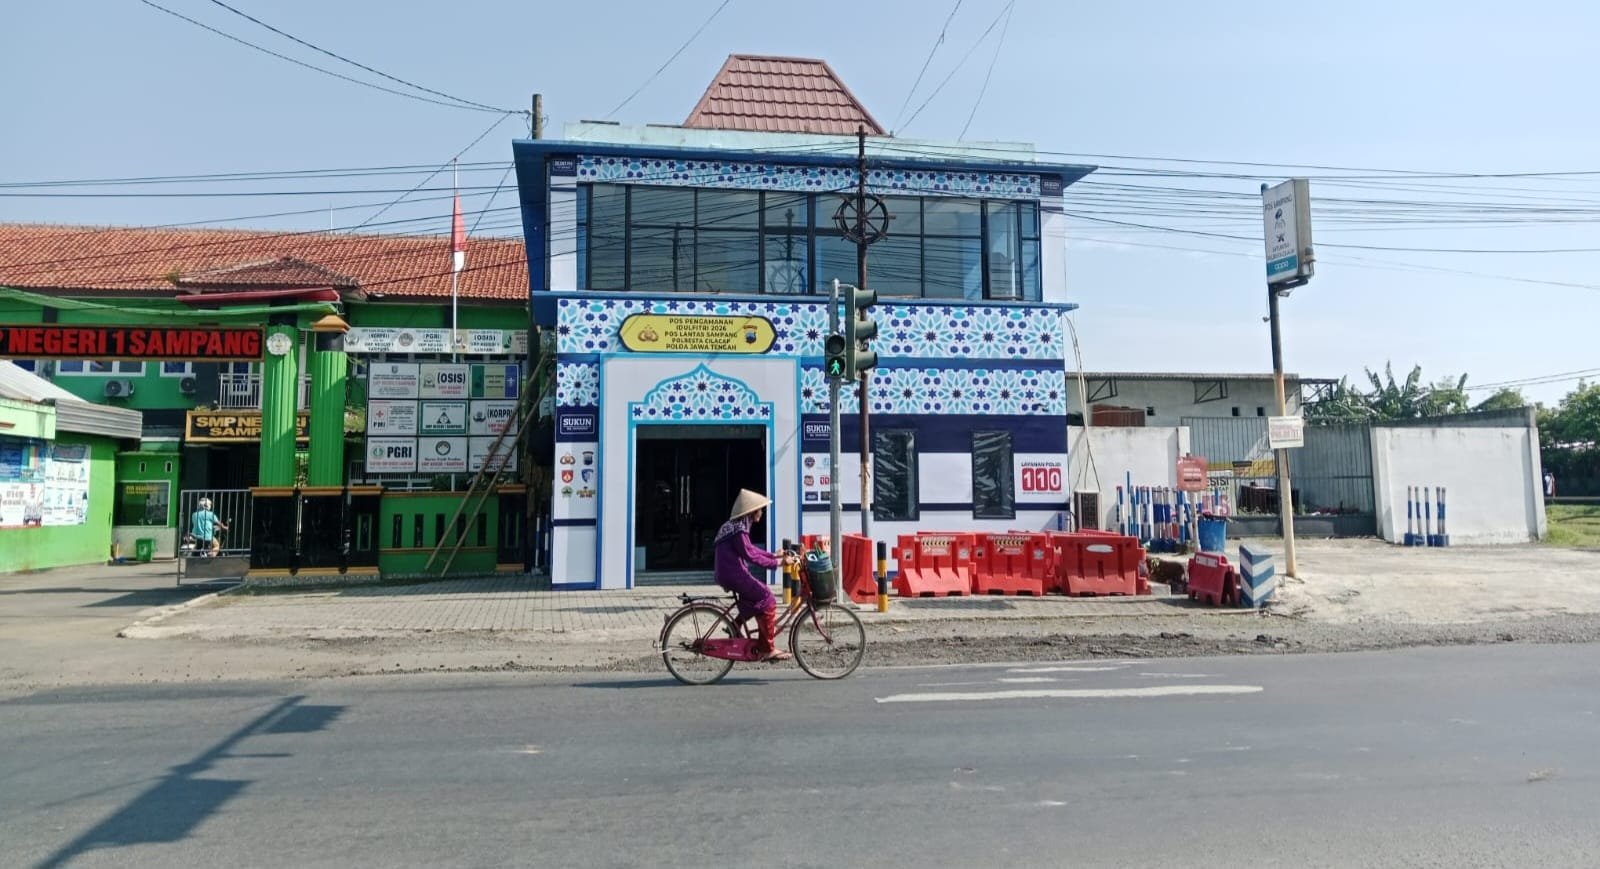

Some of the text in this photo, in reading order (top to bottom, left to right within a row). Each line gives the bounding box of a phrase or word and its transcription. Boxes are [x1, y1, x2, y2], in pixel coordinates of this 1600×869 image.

[8, 328, 107, 354] NEGERI
[112, 329, 125, 354] 1
[129, 329, 259, 356] SAMPANG
[437, 372, 466, 384] (OSIS)
[196, 416, 236, 427] SMP
[563, 418, 592, 426] SUKUN
[387, 446, 412, 458] PGRI
[1023, 471, 1060, 489] 110
